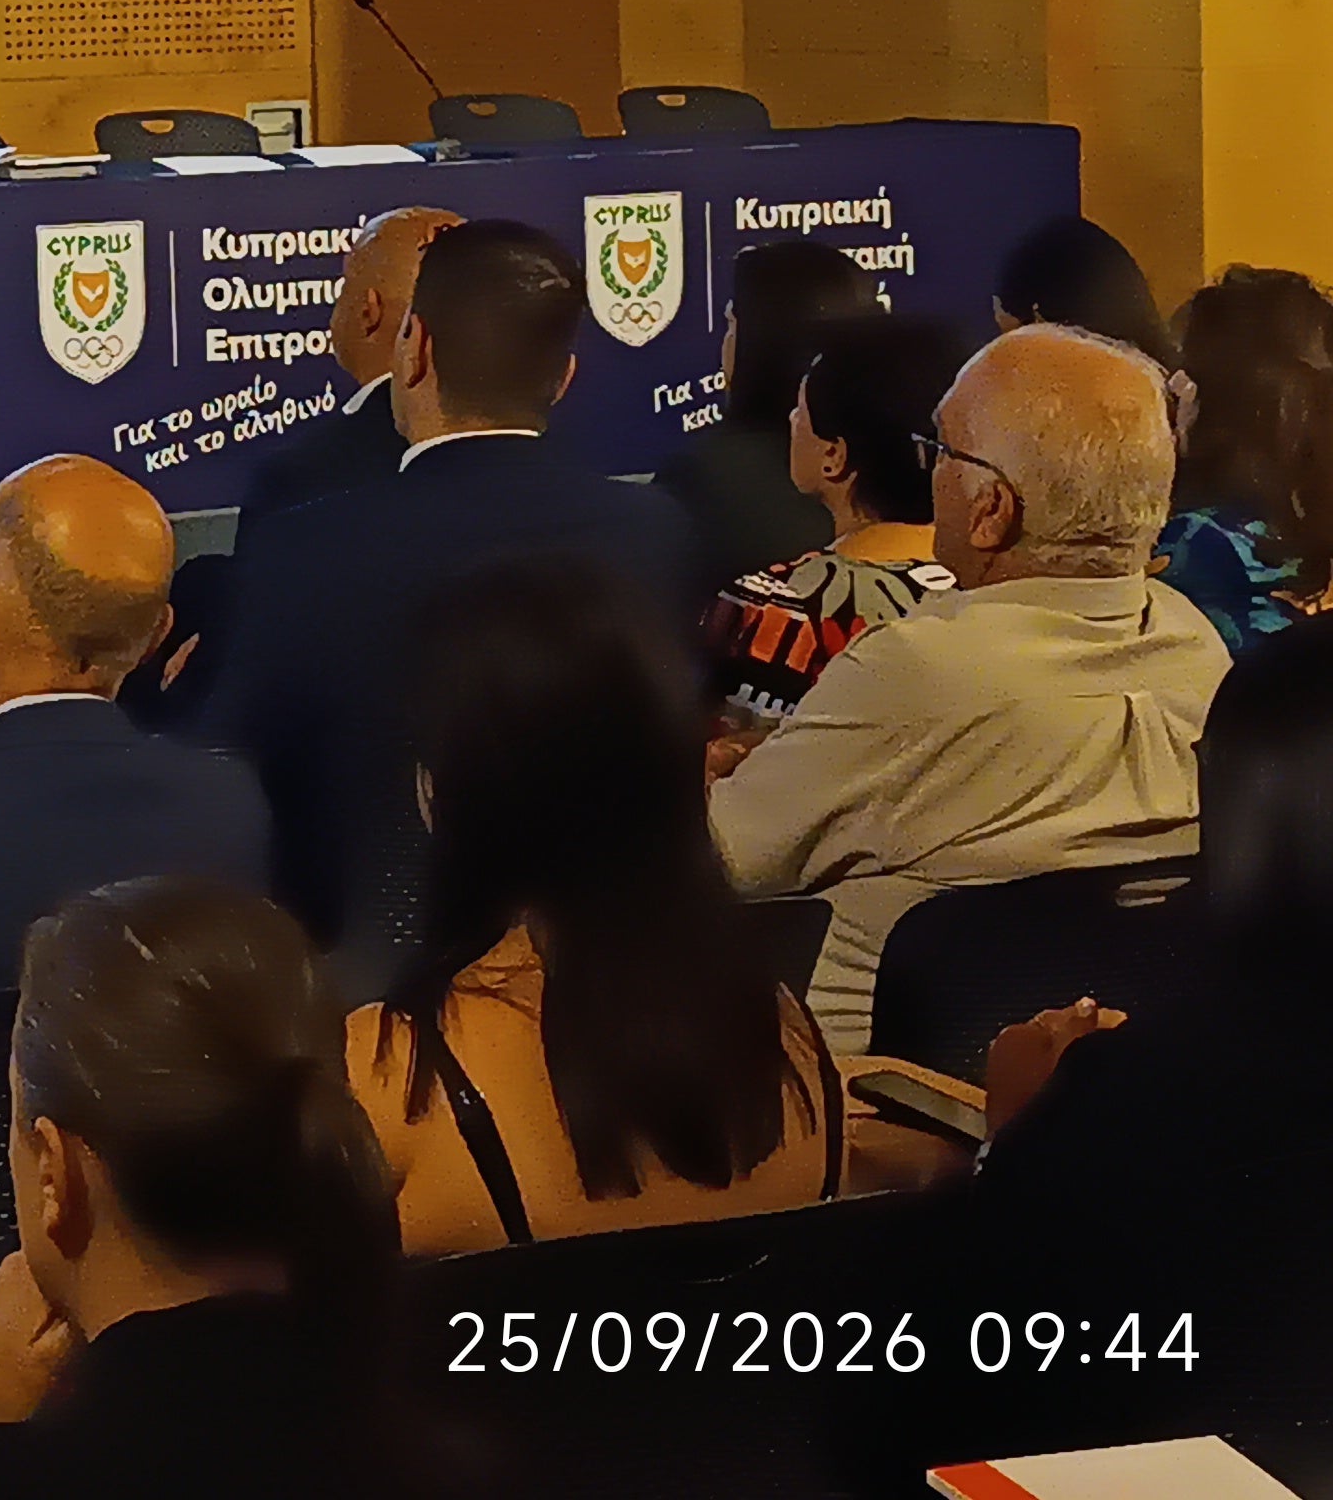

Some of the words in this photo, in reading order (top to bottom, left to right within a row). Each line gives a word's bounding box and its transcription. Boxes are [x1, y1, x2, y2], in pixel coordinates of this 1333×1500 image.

[593, 202, 672, 226] CYPRUS
[735, 185, 892, 235] Κυπριακή
[46, 232, 132, 257] CYPRUS
[202, 276, 345, 315] Ολυμπι
[206, 328, 334, 366] Επιτρο
[654, 380, 694, 413] Για
[699, 371, 726, 394] το
[113, 416, 157, 453] Για
[159, 408, 193, 433] το
[201, 374, 277, 422] ωραίο
[145, 443, 189, 473] και
[194, 428, 225, 454] το
[233, 380, 336, 442] αληθινό
[682, 403, 723, 432] και
